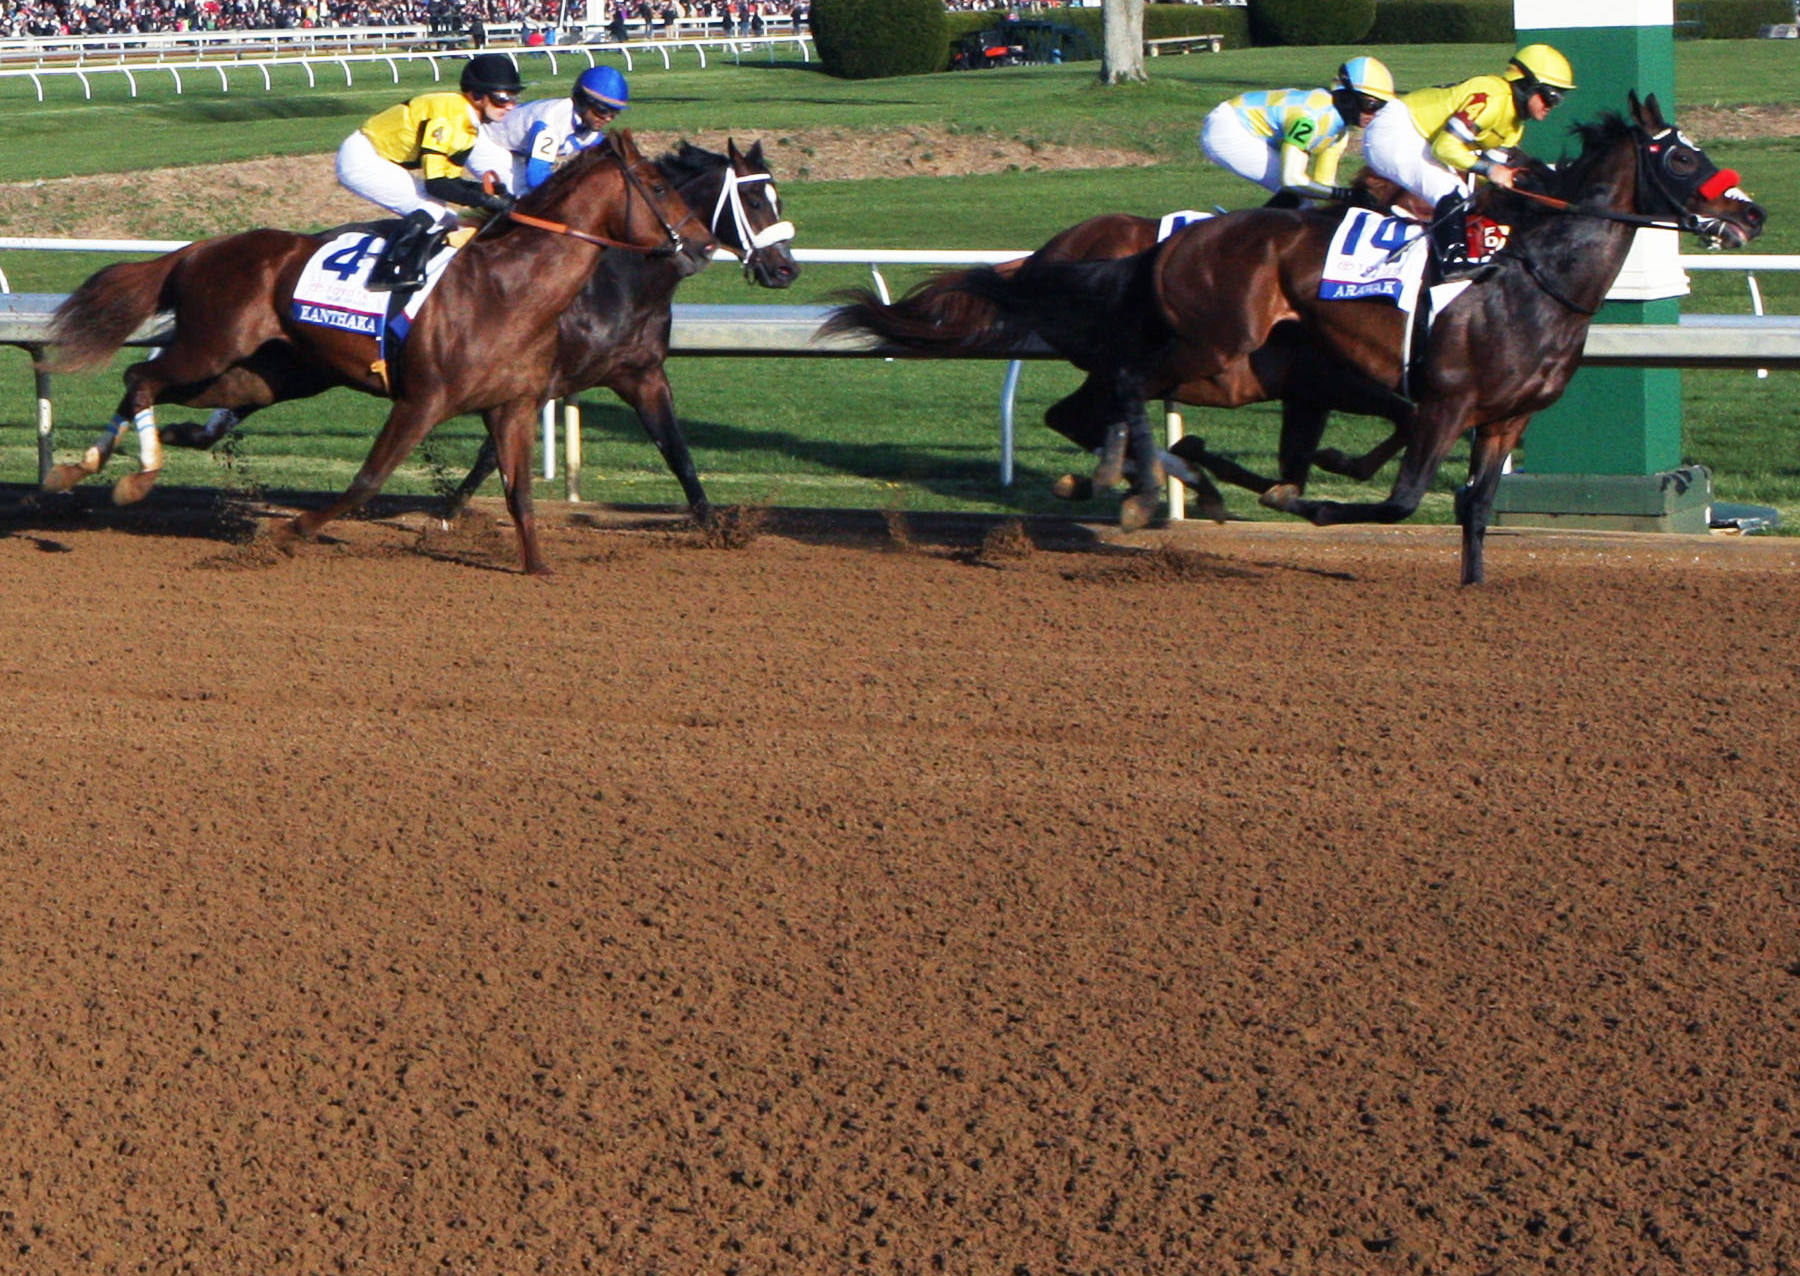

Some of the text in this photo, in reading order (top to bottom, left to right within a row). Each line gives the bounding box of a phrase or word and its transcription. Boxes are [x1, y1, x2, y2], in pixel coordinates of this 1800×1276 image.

[540, 136, 554, 154] 2
[1288, 119, 1313, 143] 12
[1341, 212, 1411, 262] 14
[322, 234, 376, 281] 4
[300, 305, 376, 333] KANTHAKA
